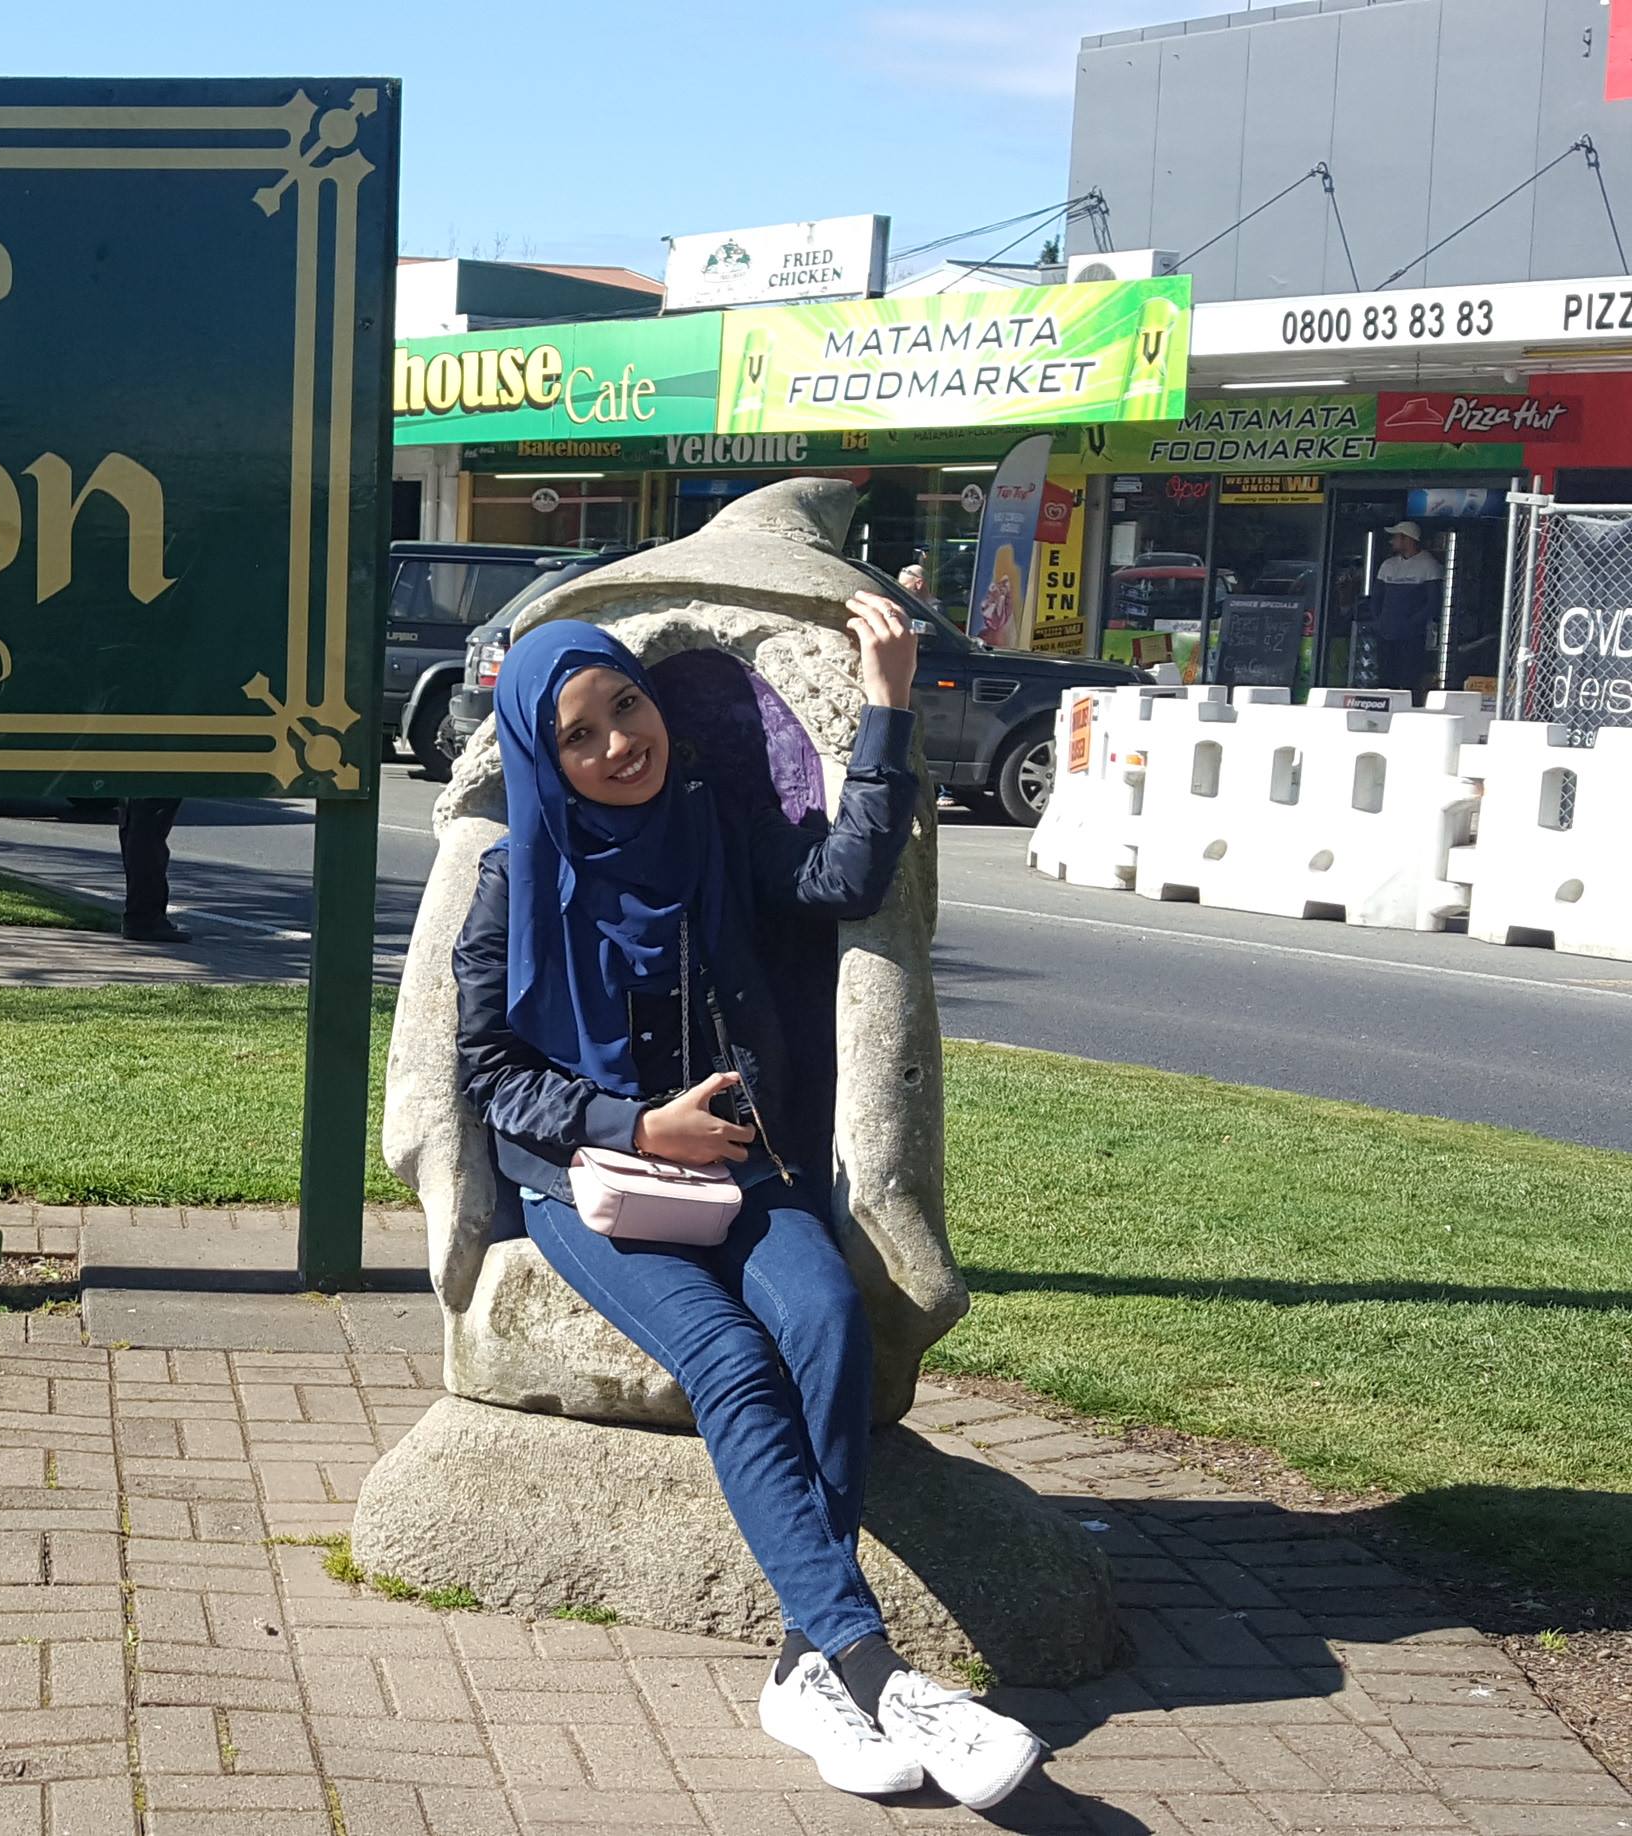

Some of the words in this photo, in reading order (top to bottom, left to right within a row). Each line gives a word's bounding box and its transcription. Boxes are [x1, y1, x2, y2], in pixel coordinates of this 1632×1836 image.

[783, 249, 834, 269] FRIED
[768, 266, 843, 289] CHICKEN
[1282, 307, 1352, 344] 0800
[1363, 304, 1398, 340] 83
[1409, 302, 1445, 338] 83
[1456, 300, 1494, 336] 83
[825, 317, 1058, 358] MATAMATA
[393, 344, 564, 416] house
[565, 363, 656, 424] Cafe
[789, 361, 1096, 403] FOODMARKET
[1177, 406, 1359, 432] MATAMATA
[1443, 396, 1511, 433] Pizza
[1512, 399, 1568, 432] Hut
[517, 438, 621, 458] Bakehouse
[1150, 436, 1377, 462] FOODMARKET
[1225, 476, 1281, 485] WESTERN
[1241, 484, 1280, 492] UNION
[1345, 696, 1387, 710] Hirepool
